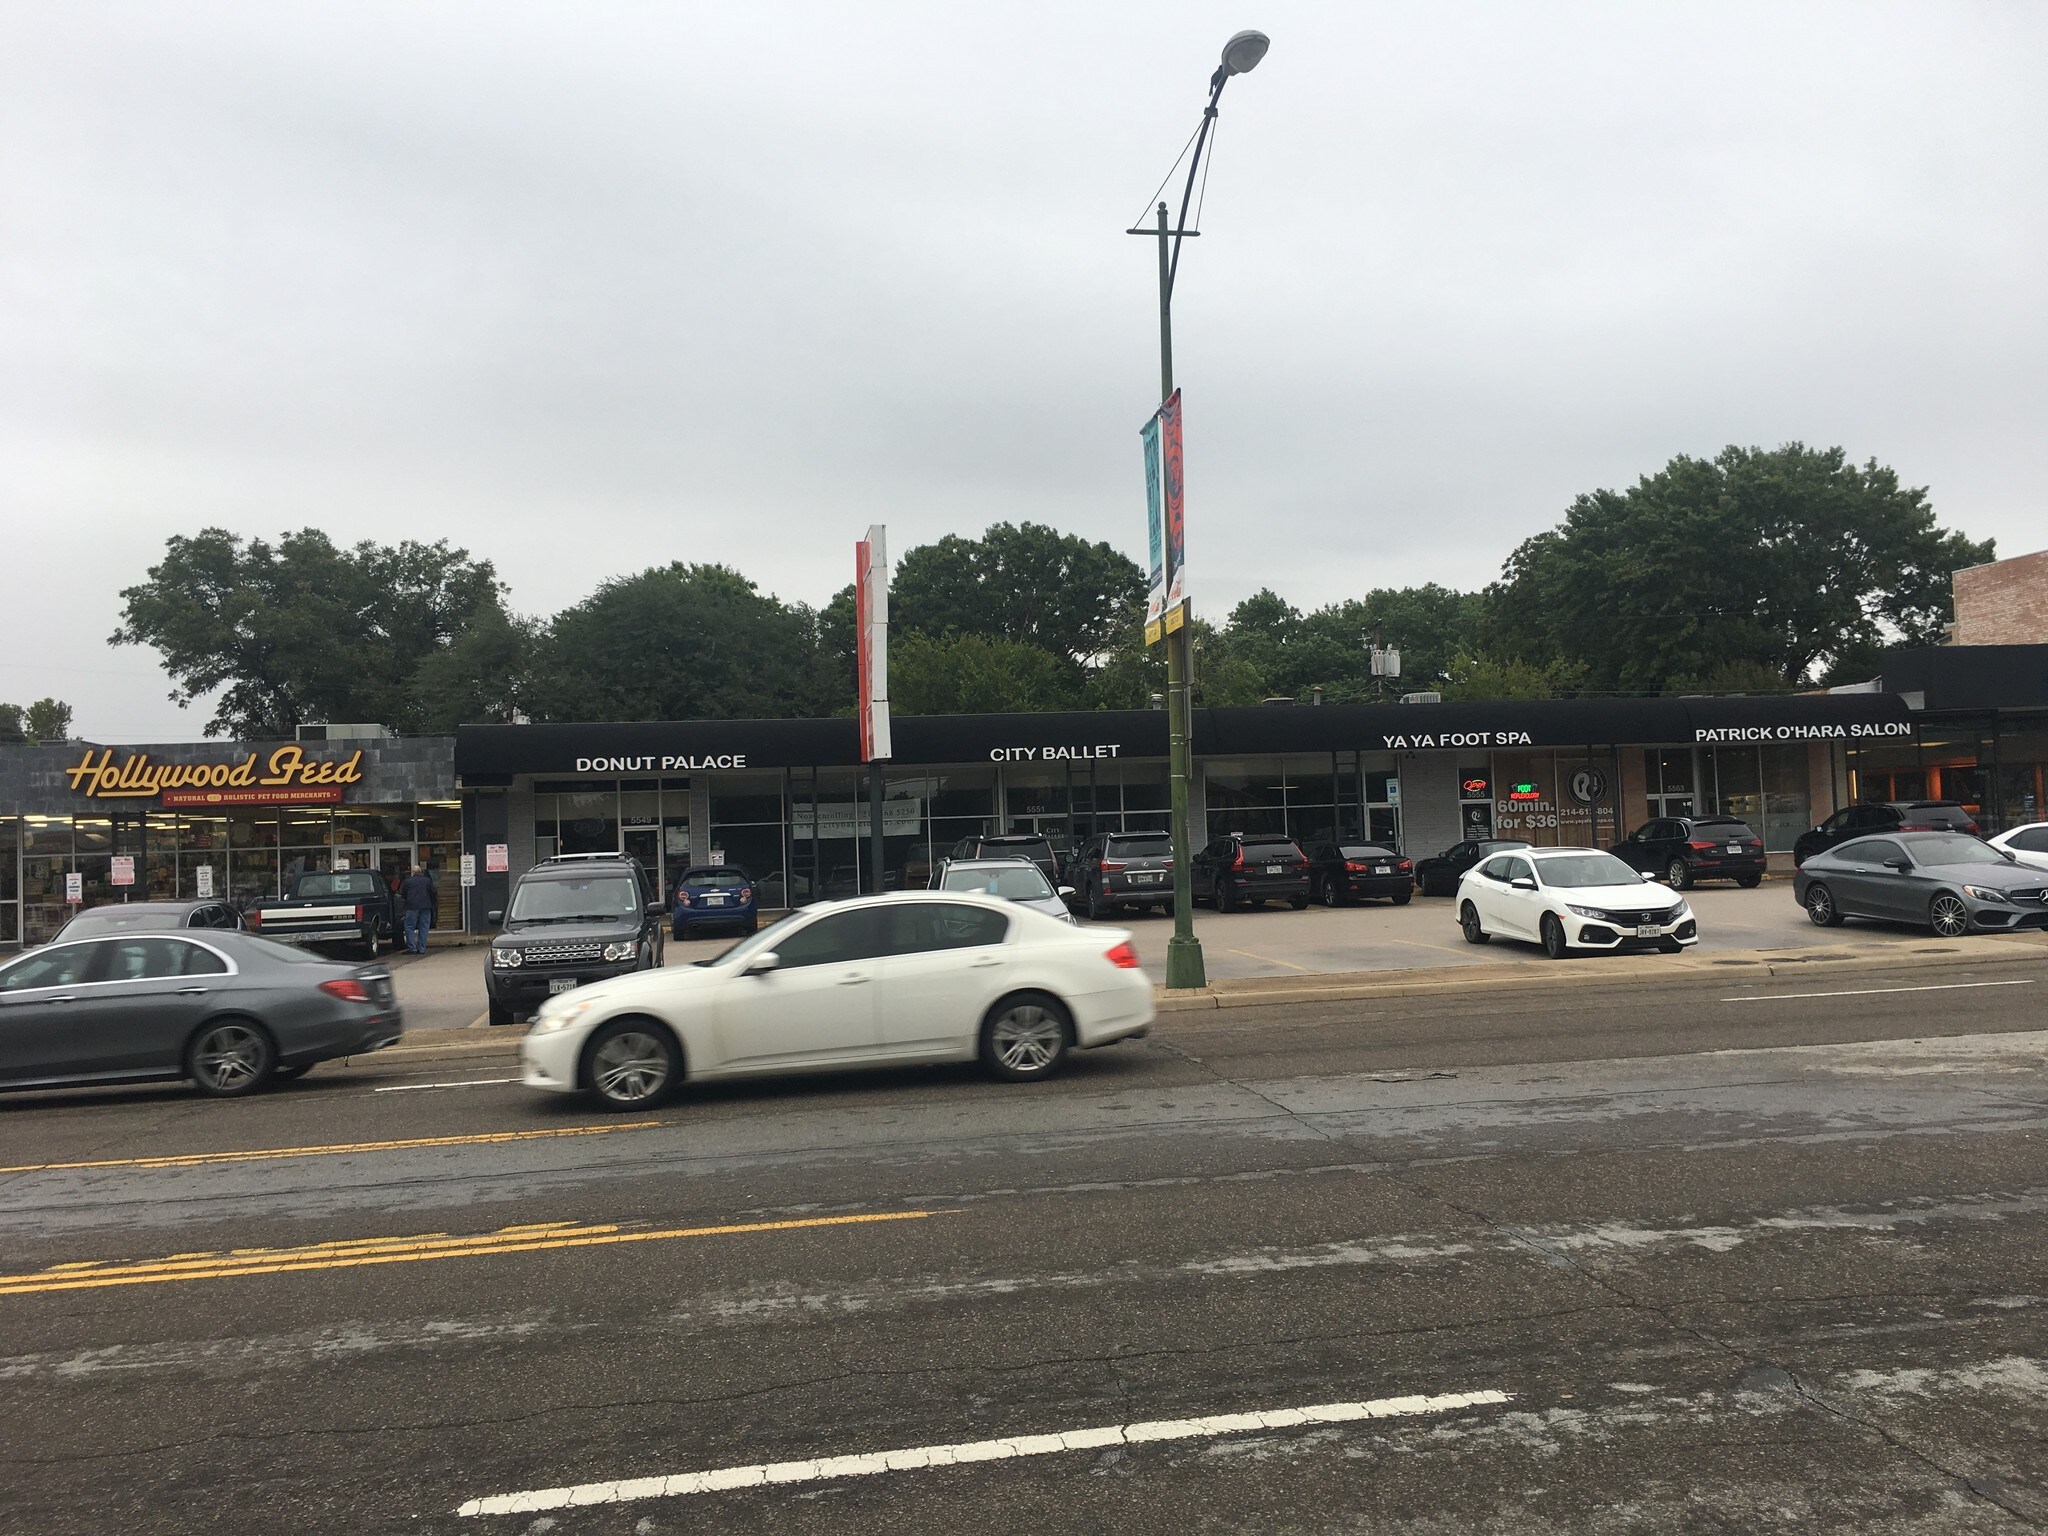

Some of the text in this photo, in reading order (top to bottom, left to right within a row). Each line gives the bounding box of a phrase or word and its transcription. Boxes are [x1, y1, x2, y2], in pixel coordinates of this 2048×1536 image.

[1695, 722, 1911, 741] PATRICK O'HARA SALON
[1383, 731, 1532, 748] YA YA FOOT SPA
[990, 744, 1121, 761] CITY BALLET
[576, 754, 747, 772] DONUT PALACE
[65, 746, 362, 797] Hollywood Feed
[1463, 780, 1486, 791] Open
[1517, 784, 1532, 793] FOOT
[223, 793, 256, 801] HOLISTIC
[271, 792, 289, 800] FOOD
[290, 791, 331, 799] MERCHANTS
[1467, 791, 1486, 799] 5555
[896, 807, 915, 816] 5250
[1026, 805, 1045, 814] 5551
[1497, 799, 1555, 813] 60min.
[631, 817, 652, 825] 5549
[1496, 814, 1558, 829] for $36
